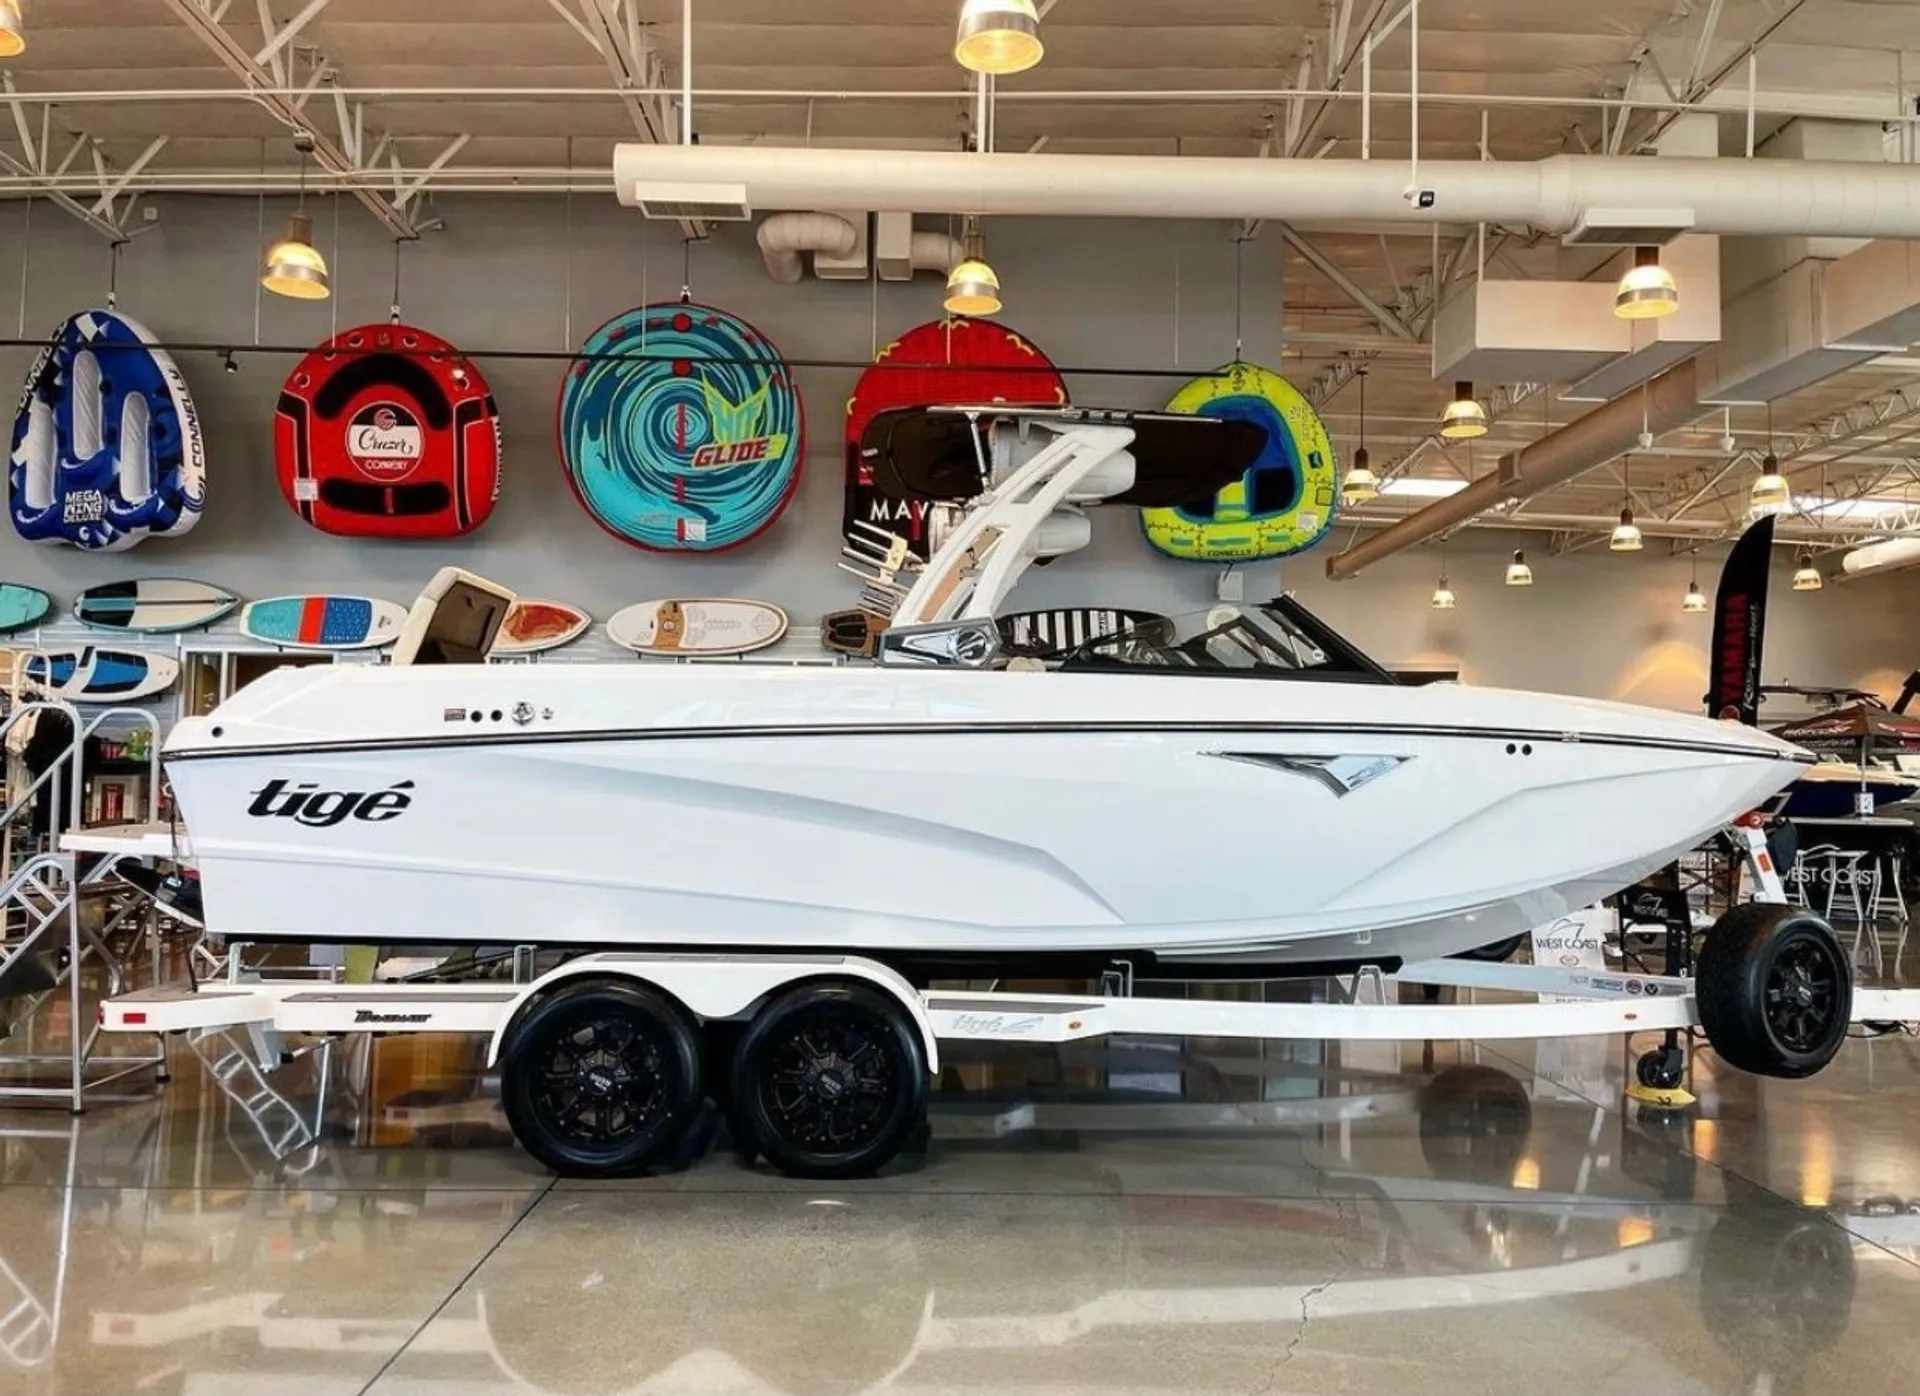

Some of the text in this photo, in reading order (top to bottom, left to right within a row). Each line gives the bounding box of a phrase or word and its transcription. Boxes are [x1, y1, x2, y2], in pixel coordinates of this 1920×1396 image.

[168, 367, 203, 468] CONNELLY
[358, 428, 414, 455] Cruzer
[65, 489, 102, 504] MEGA
[1720, 594, 1748, 702] YAMAHA
[247, 779, 416, 828] tigé
[1536, 937, 1599, 951] WEST COAST
